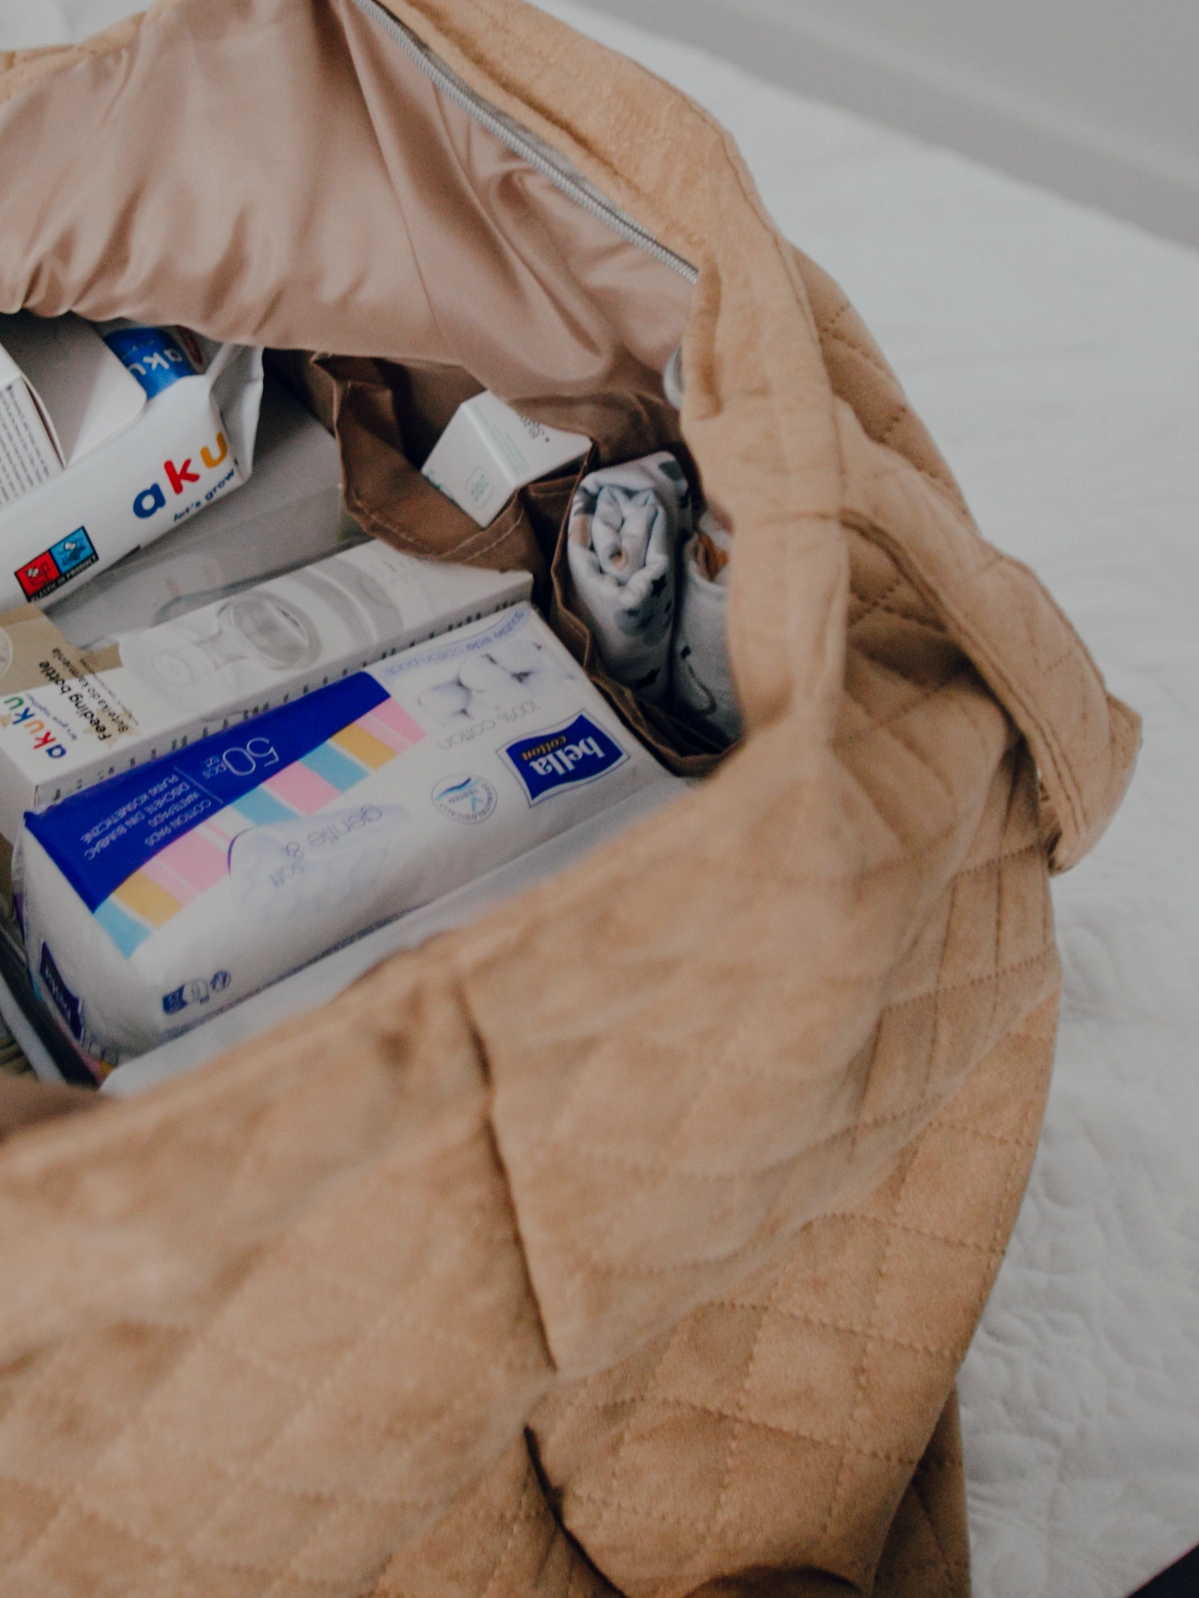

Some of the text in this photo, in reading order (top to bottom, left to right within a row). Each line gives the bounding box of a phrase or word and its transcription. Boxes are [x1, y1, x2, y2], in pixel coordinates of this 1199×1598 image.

[202, 468, 235, 501] grow
[57, 576, 66, 585] IN
[64, 555, 97, 579] PRODUCT
[37, 658, 72, 695] bottle
[2, 696, 66, 757] akuku
[66, 691, 111, 741] Feeding
[435, 696, 541, 751] 100% cotton
[220, 733, 281, 781] 50
[519, 734, 568, 762] cotton
[528, 735, 604, 777] bella
[83, 823, 128, 860] BUMBAC
[143, 796, 213, 847] COTTON PADS
[267, 805, 382, 888] gentle & soft
